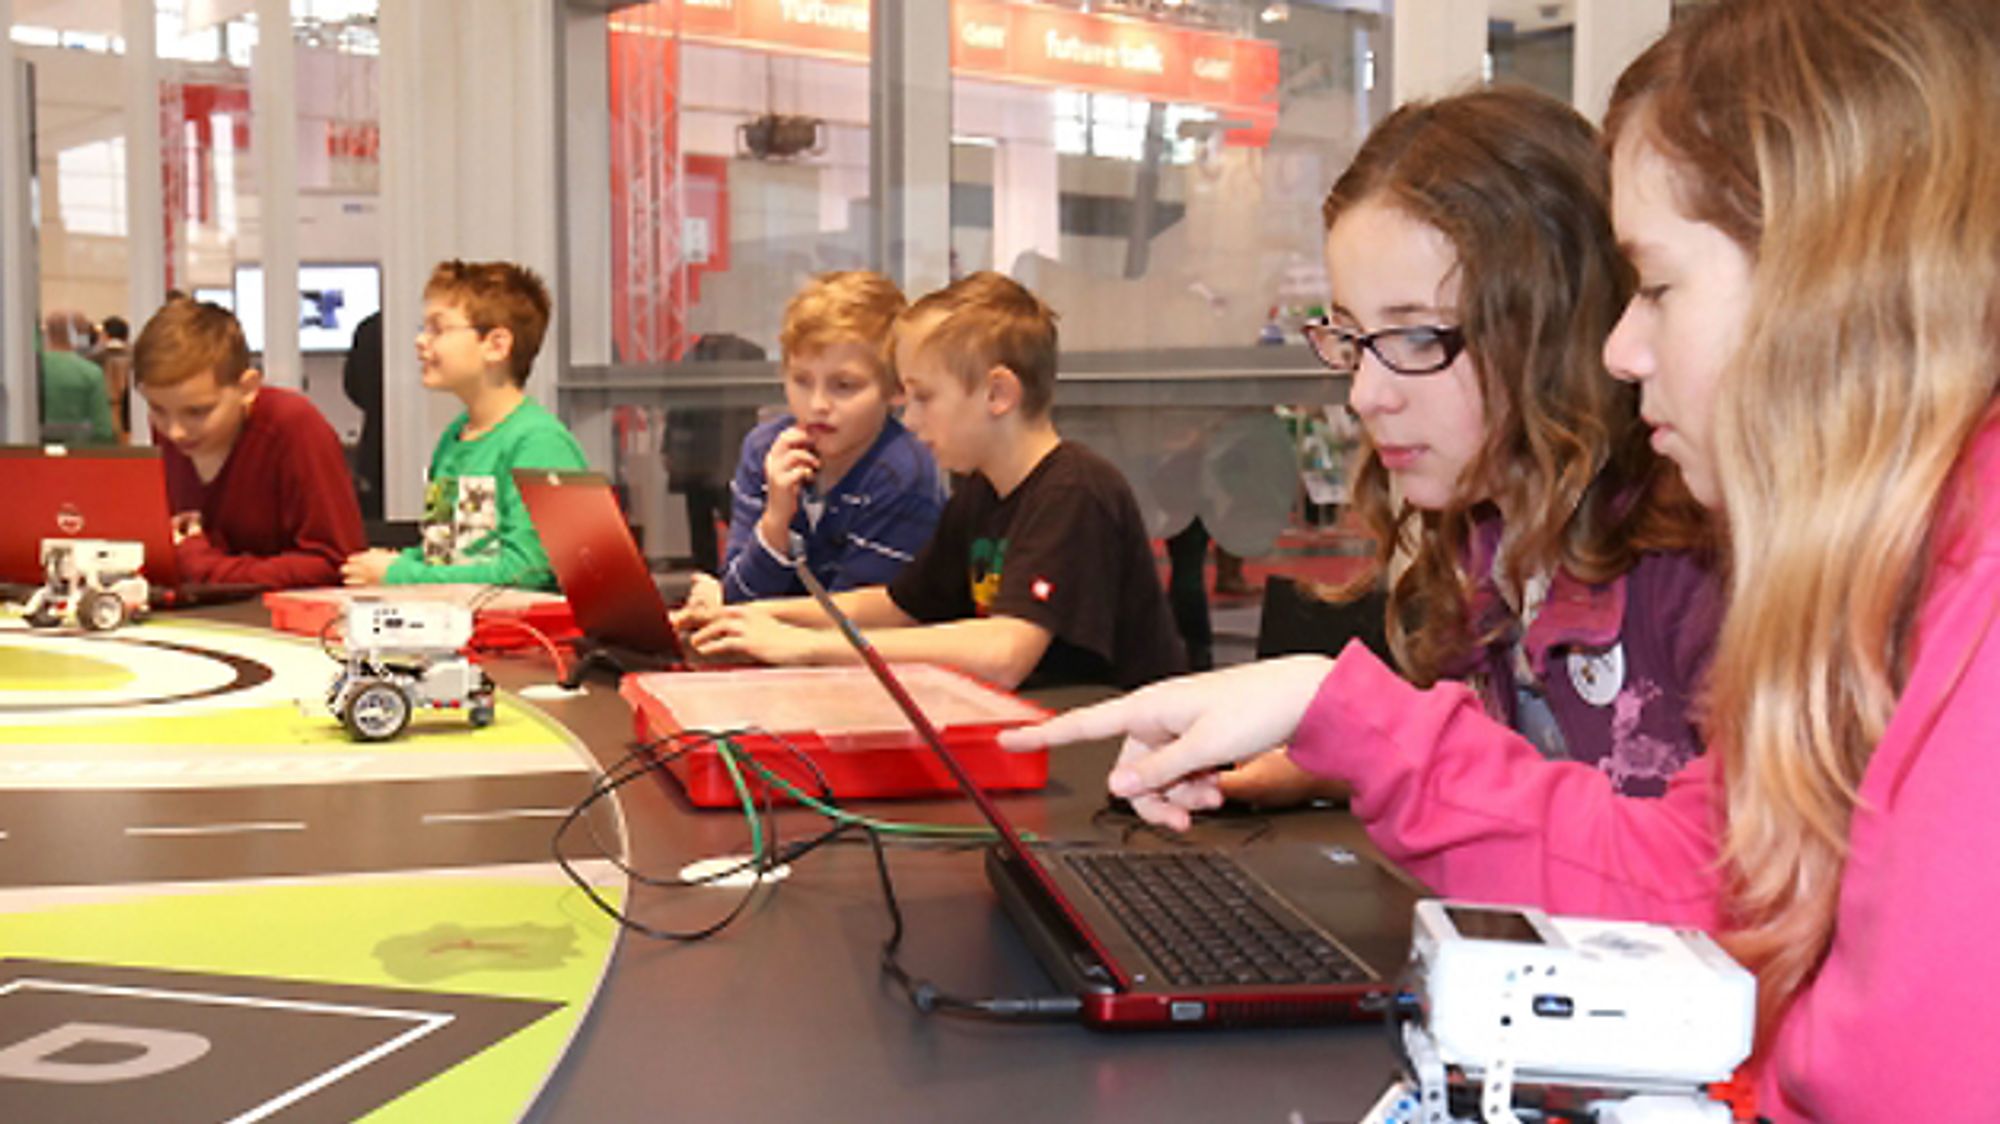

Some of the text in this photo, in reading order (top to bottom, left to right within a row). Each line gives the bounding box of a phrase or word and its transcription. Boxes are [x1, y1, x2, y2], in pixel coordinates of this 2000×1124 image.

[1045, 29, 1117, 68] future
[1118, 41, 1164, 75] talk
[0, 1022, 211, 1084] D
